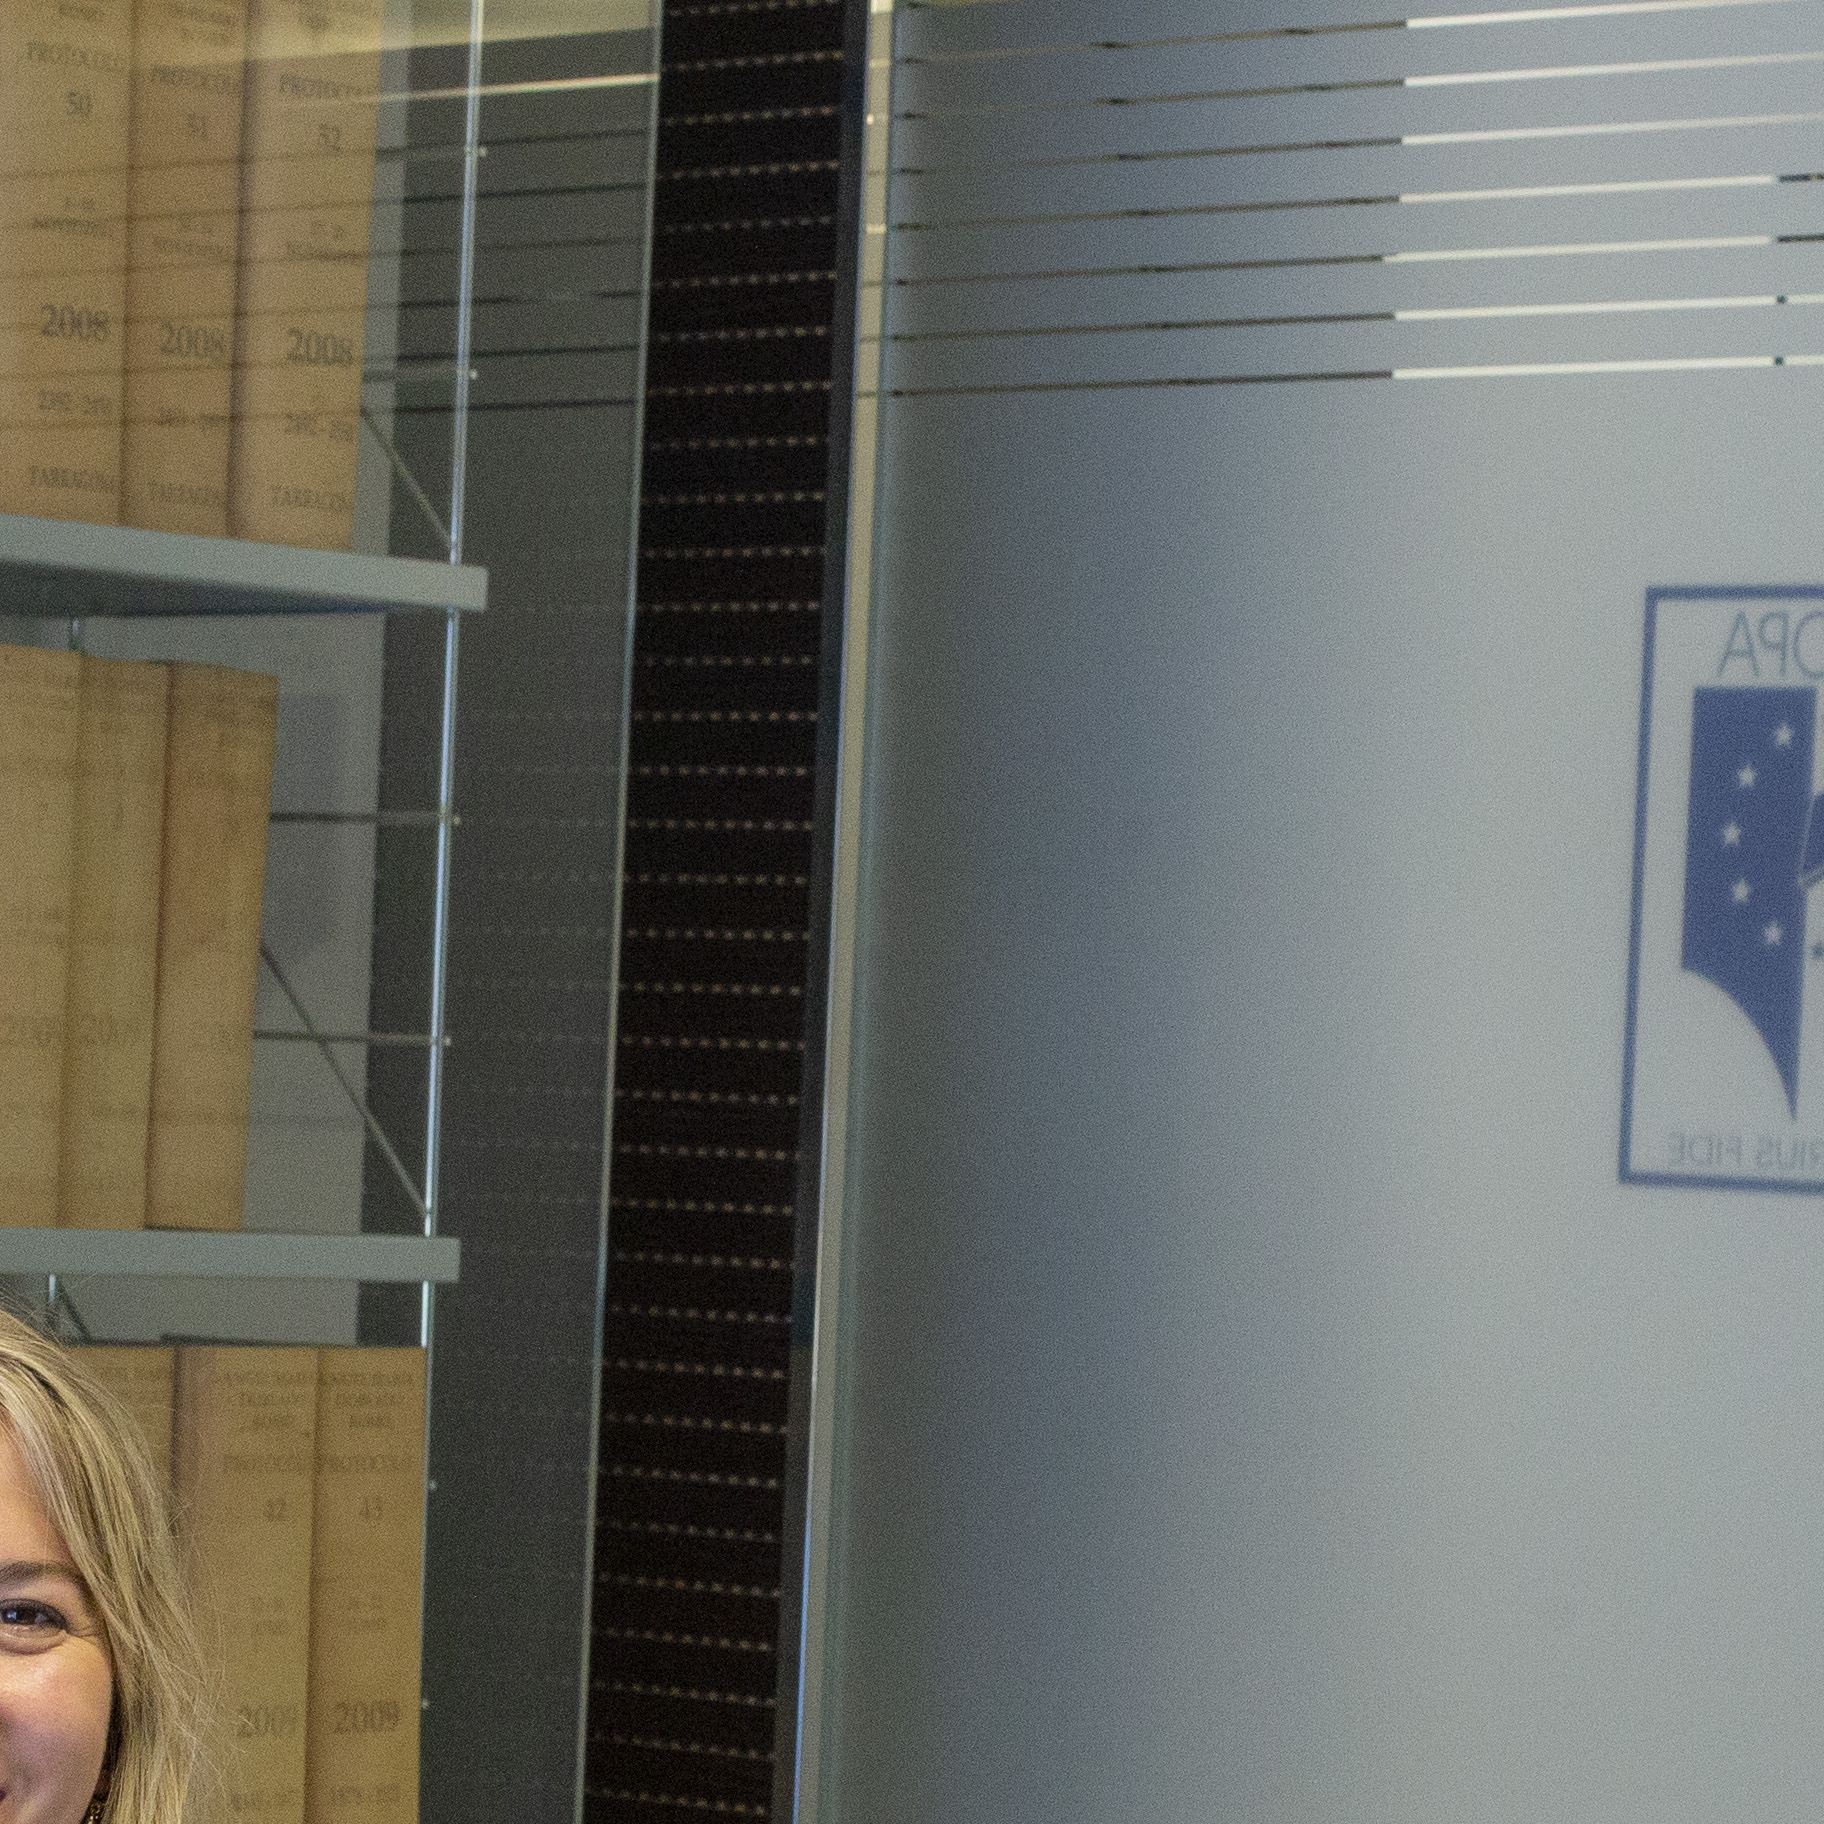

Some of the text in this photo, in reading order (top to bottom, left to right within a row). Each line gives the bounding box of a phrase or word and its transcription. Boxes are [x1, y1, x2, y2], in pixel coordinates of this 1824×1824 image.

[67, 92, 92, 119] 50
[187, 115, 209, 141] 51
[319, 125, 341, 151] 52
[40, 304, 109, 342] 2008
[159, 322, 224, 359] 2008
[287, 328, 353, 366] 2008
[237, 1704, 297, 1739] 2009
[332, 1702, 400, 1737] 2009
